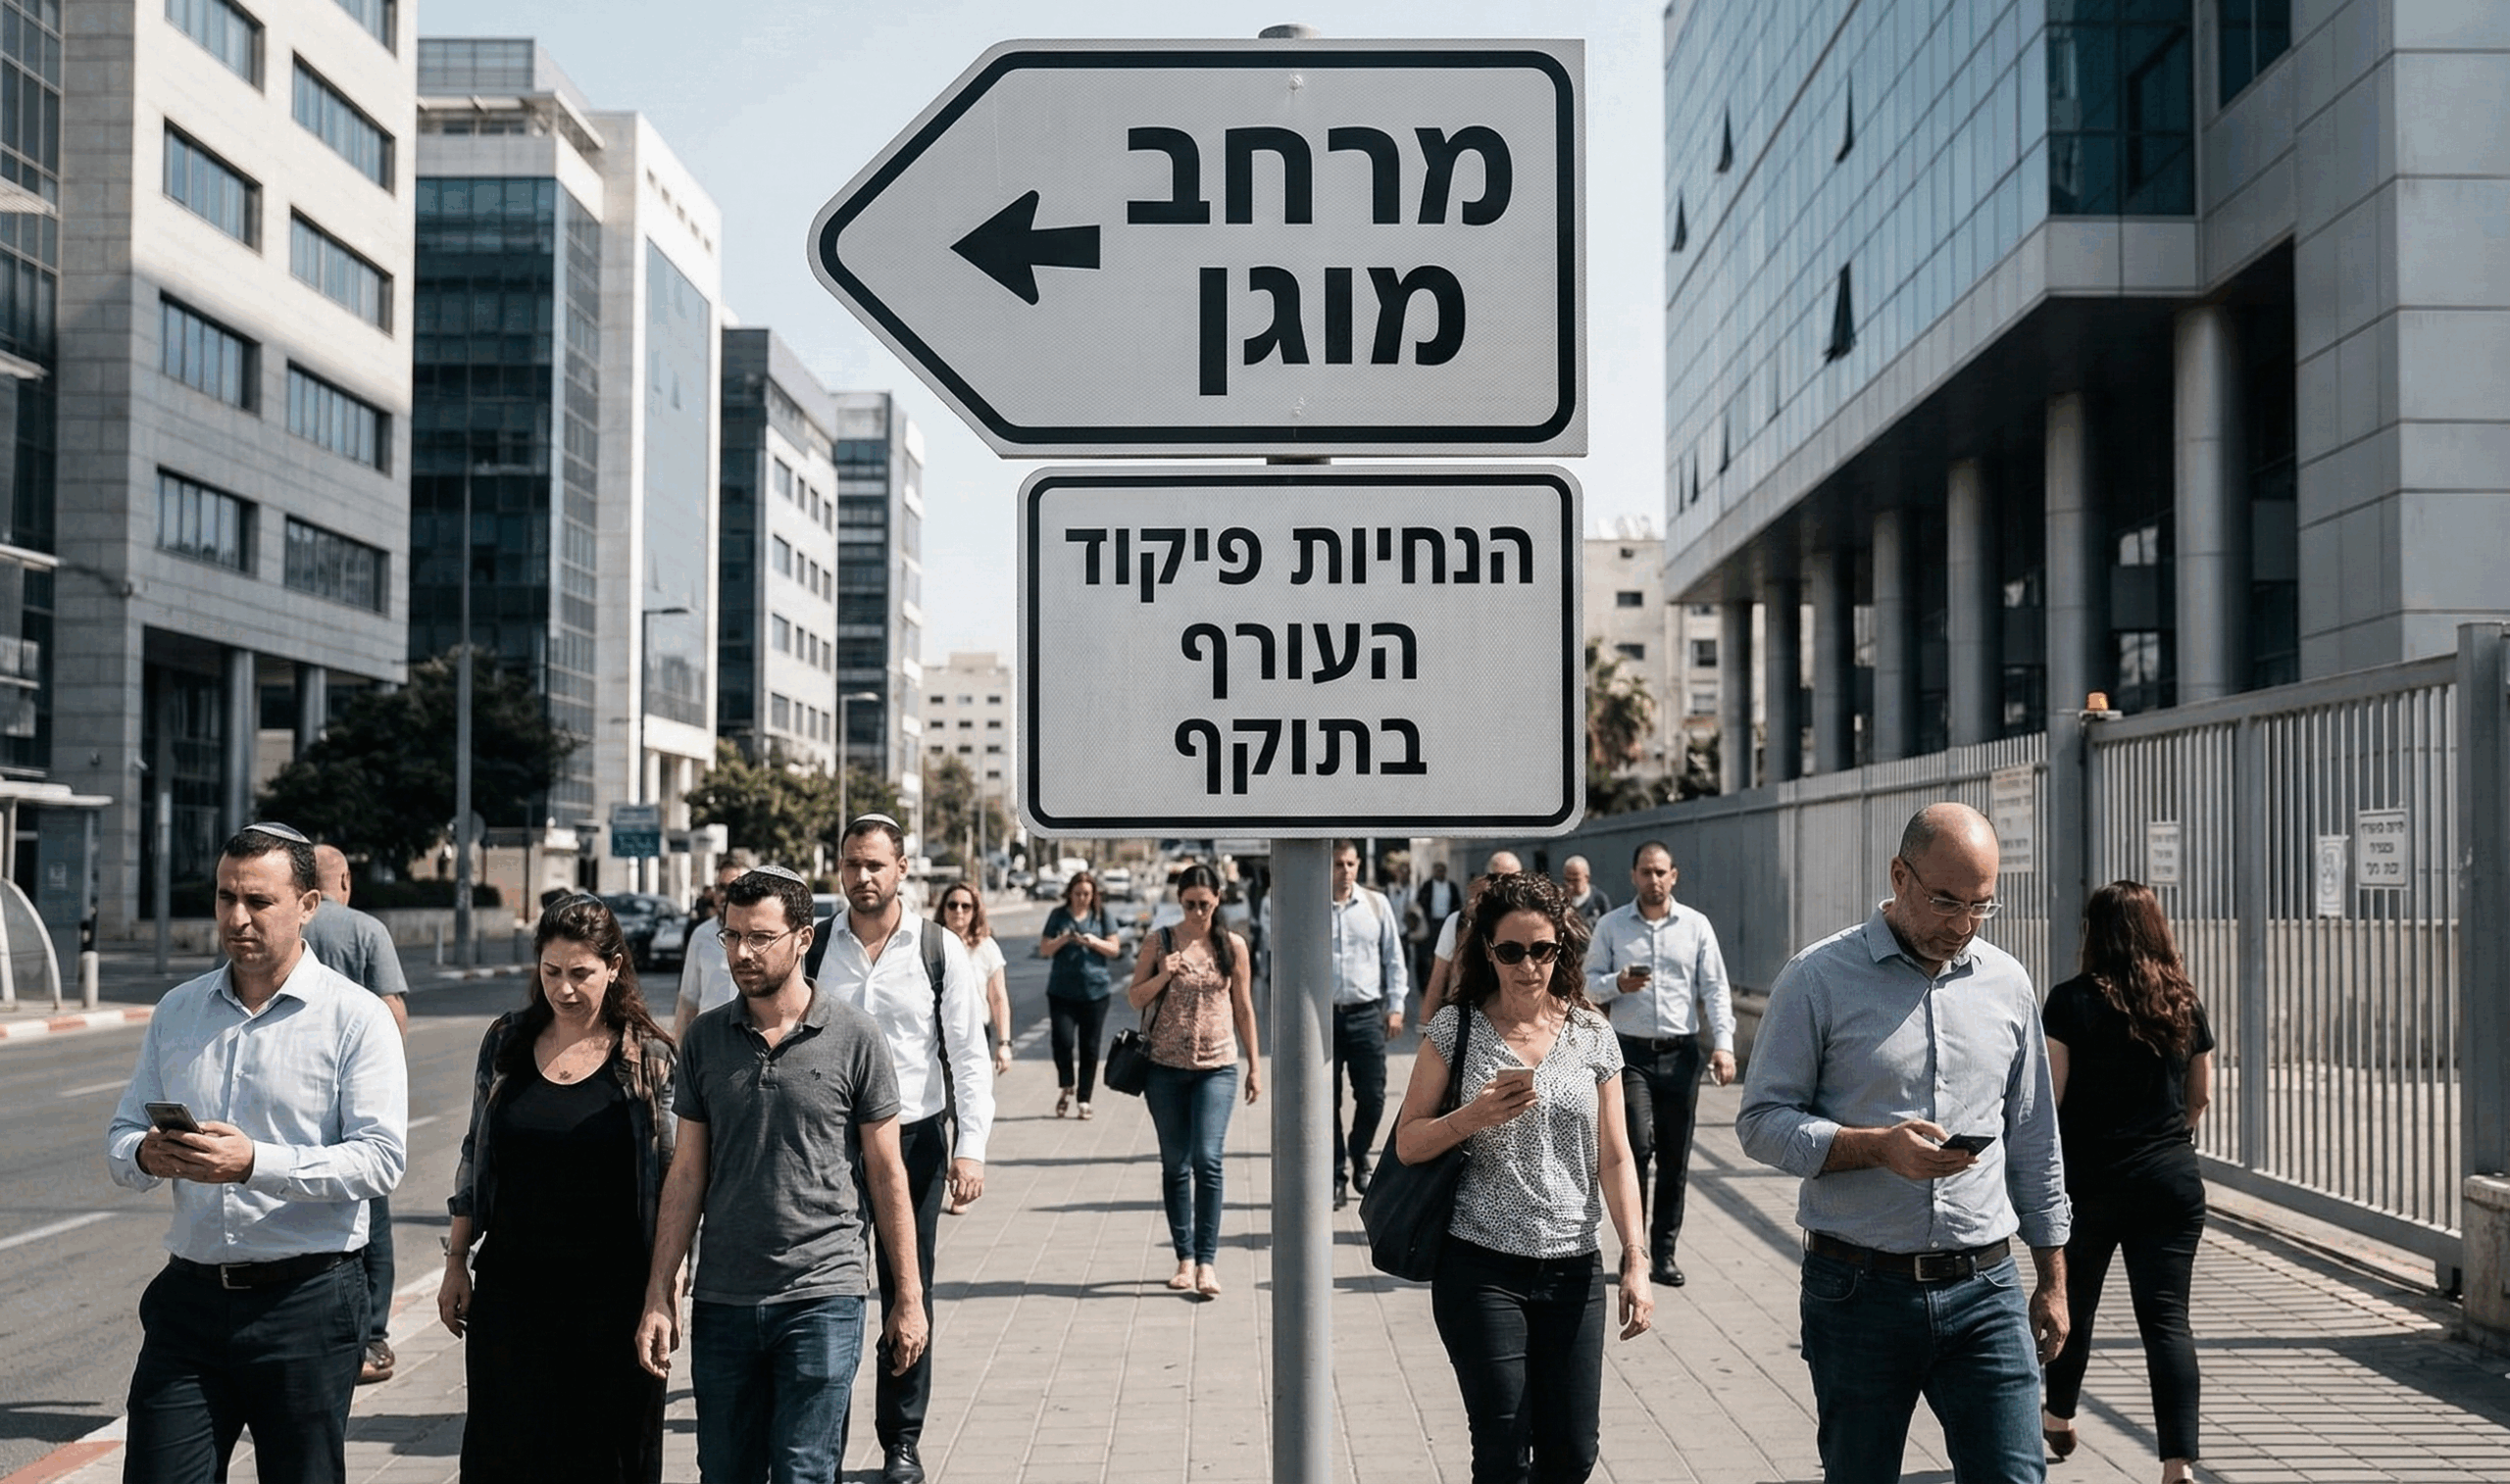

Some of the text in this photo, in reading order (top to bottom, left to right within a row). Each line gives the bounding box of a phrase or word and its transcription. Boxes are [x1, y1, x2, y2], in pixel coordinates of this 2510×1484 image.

[1128, 125, 1513, 225] מרחב
[1199, 265, 1467, 397] מוגן
[1065, 525, 1533, 604] הנחיות פיקוד
[1180, 621, 1418, 700] העורף
[1174, 717, 1428, 795] בתוקף
